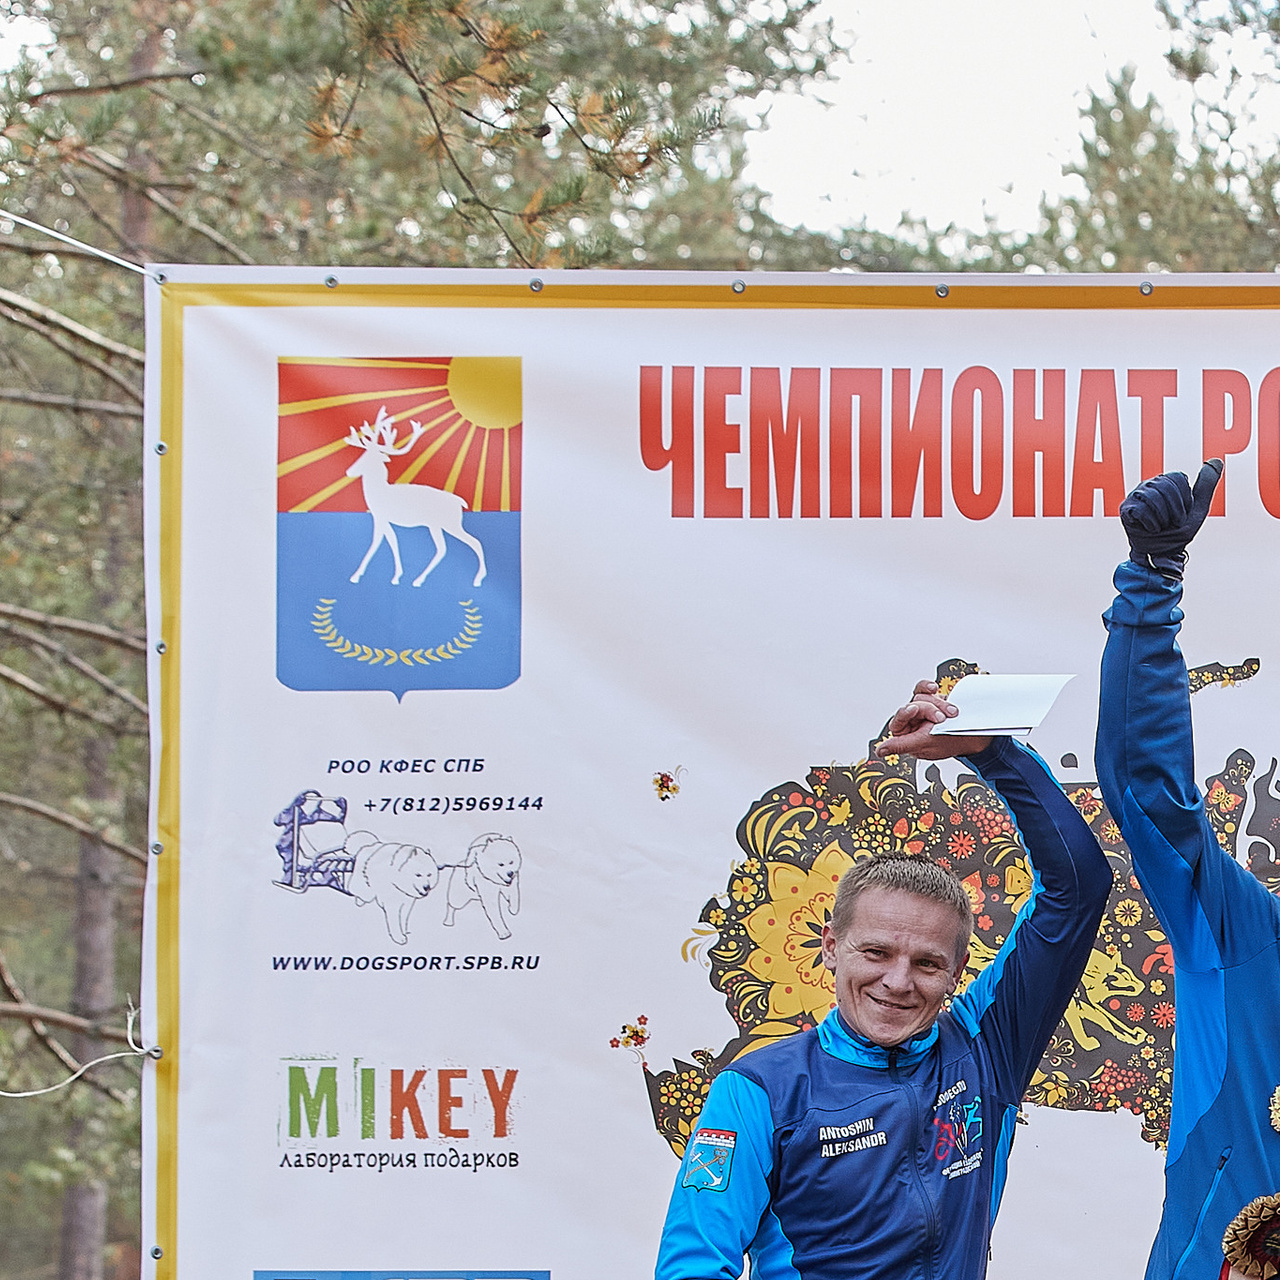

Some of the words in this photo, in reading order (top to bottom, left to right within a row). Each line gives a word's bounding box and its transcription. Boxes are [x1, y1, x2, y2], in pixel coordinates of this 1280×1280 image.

[639, 365, 1178, 521] ЧЕМПИОНАТ
[327, 760, 371, 774] РОО
[379, 759, 436, 773] КФЕС
[443, 758, 485, 773] СПБ
[364, 797, 544, 815] +7(812)5969144
[272, 956, 541, 971] WWW.DOGSPORT.SPB.RU
[288, 1065, 519, 1140] MIKEY
[819, 1118, 874, 1141] ANTOSHIN
[821, 1131, 887, 1158] ALEKSANDR
[279, 1152, 417, 1173] лаборатория
[423, 1147, 520, 1173] подарков
